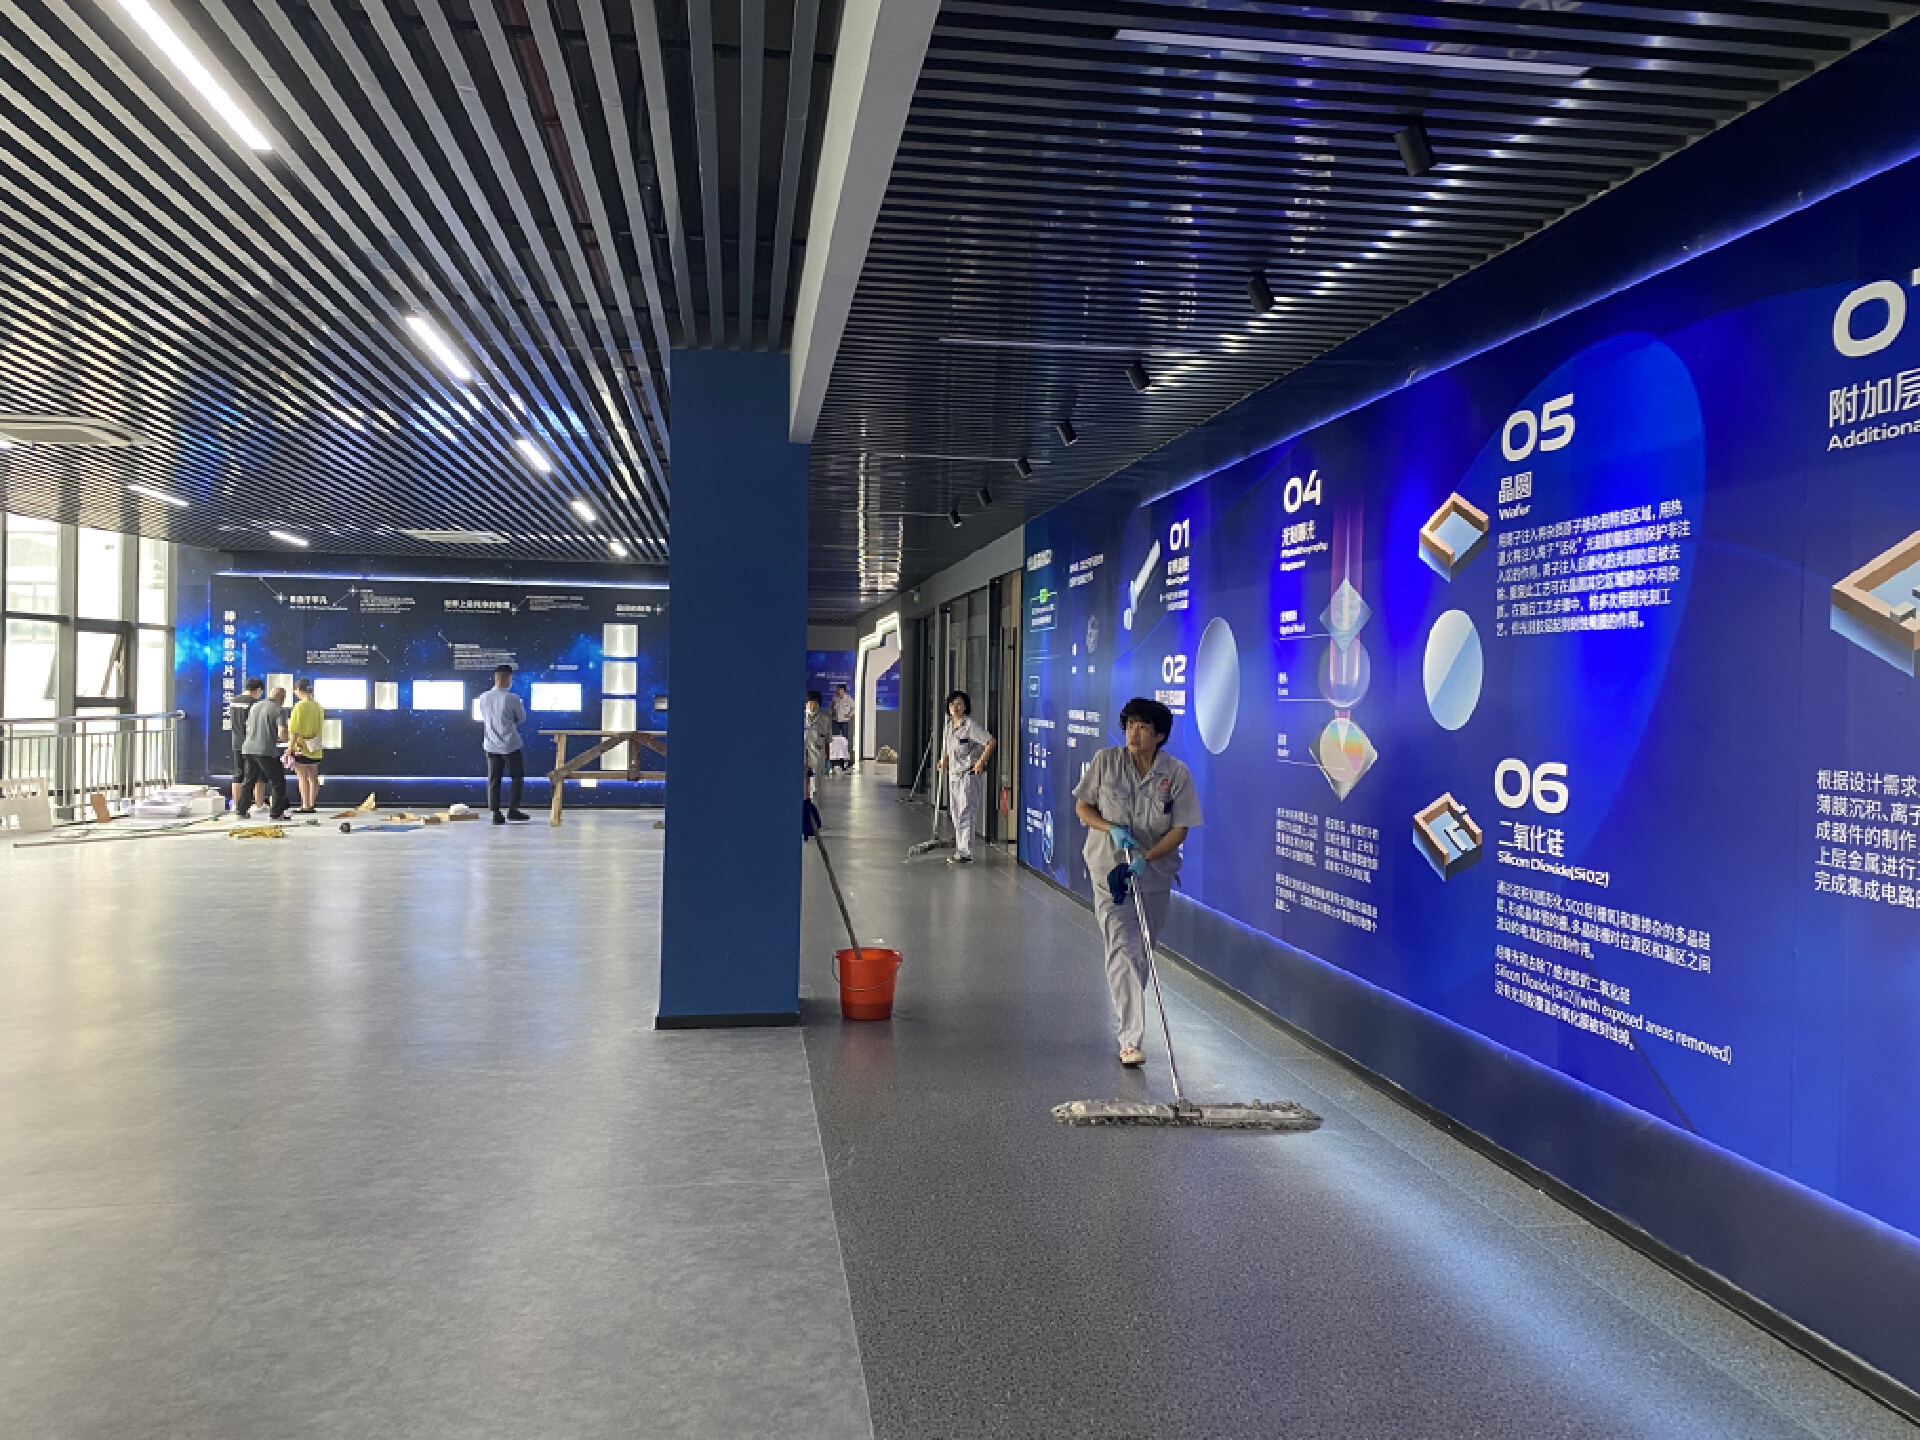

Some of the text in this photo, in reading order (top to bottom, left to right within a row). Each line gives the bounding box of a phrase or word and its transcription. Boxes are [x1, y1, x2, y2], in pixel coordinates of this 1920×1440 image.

[1832, 267, 1920, 357] 0
[1502, 394, 1575, 461] 05
[1284, 469, 1322, 514] 04
[1499, 471, 1532, 503] 晶圆
[1170, 517, 1190, 551] 01
[1162, 654, 1187, 684] 02
[1495, 758, 1569, 814] 06
[1816, 768, 1920, 797] 根据设计需求
[1498, 820, 1565, 857] 二氧化硅
[1815, 820, 1920, 851] 成器件的制作
[1815, 846, 1920, 880] 上层金属进行
[1602, 1005, 1643, 1030] exposed
[1646, 1021, 1674, 1042] areas
